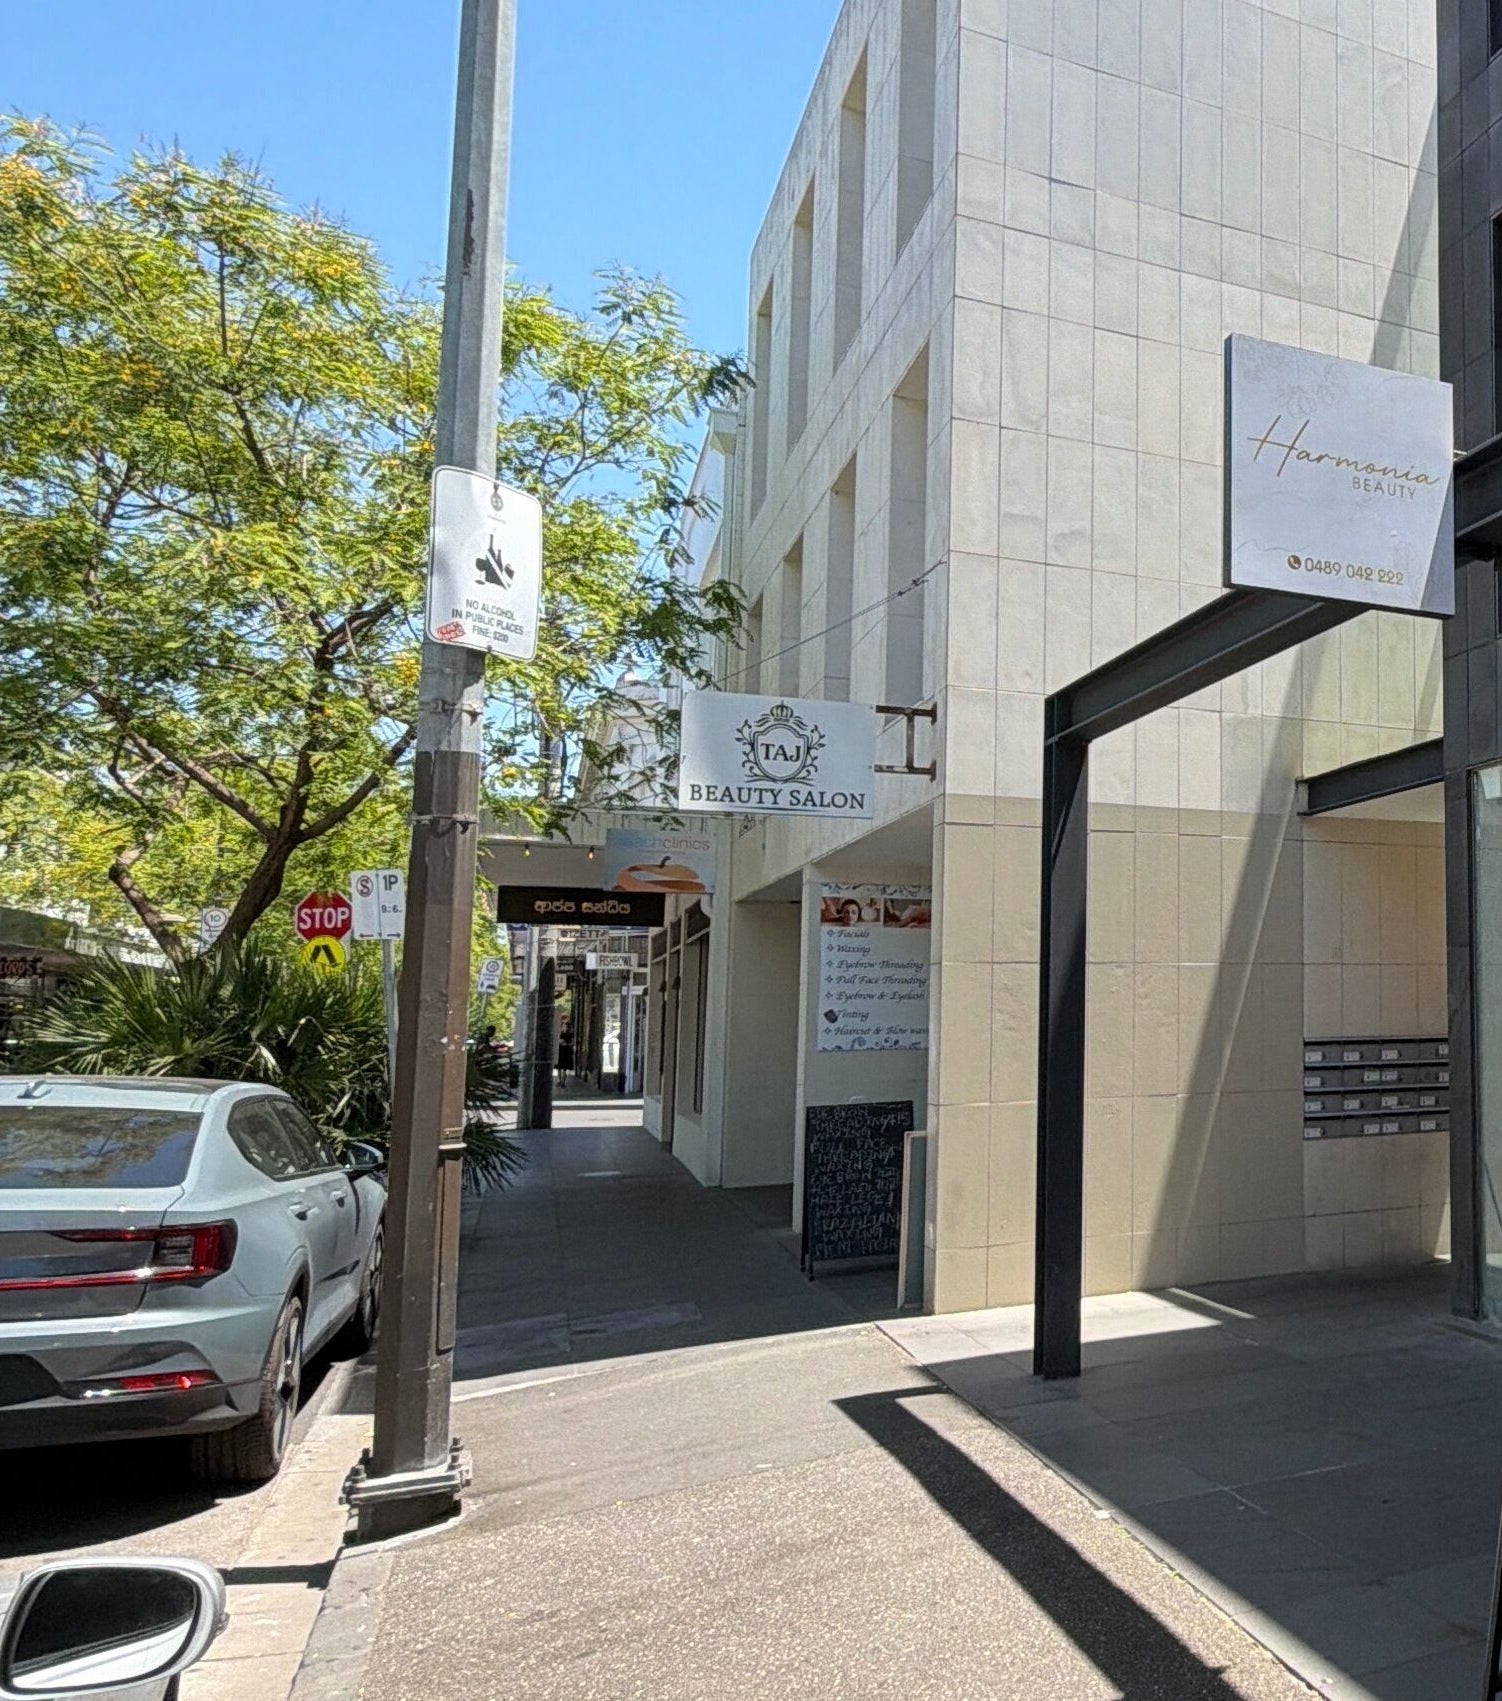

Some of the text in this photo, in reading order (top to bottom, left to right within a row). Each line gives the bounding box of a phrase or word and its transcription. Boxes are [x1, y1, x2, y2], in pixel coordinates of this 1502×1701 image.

[1247, 414, 1440, 486] Harmonia
[1352, 477, 1417, 500] BEAUTY
[1304, 557, 1404, 586] 0489 042 222
[452, 608, 524, 635] IN PUBLIC PLACES
[466, 599, 516, 621] NO ALCOHOL
[760, 743, 802, 763] TAJ
[690, 784, 866, 810] BEAUTY SALON
[383, 875, 398, 891] 1P
[299, 907, 350, 930] STOP
